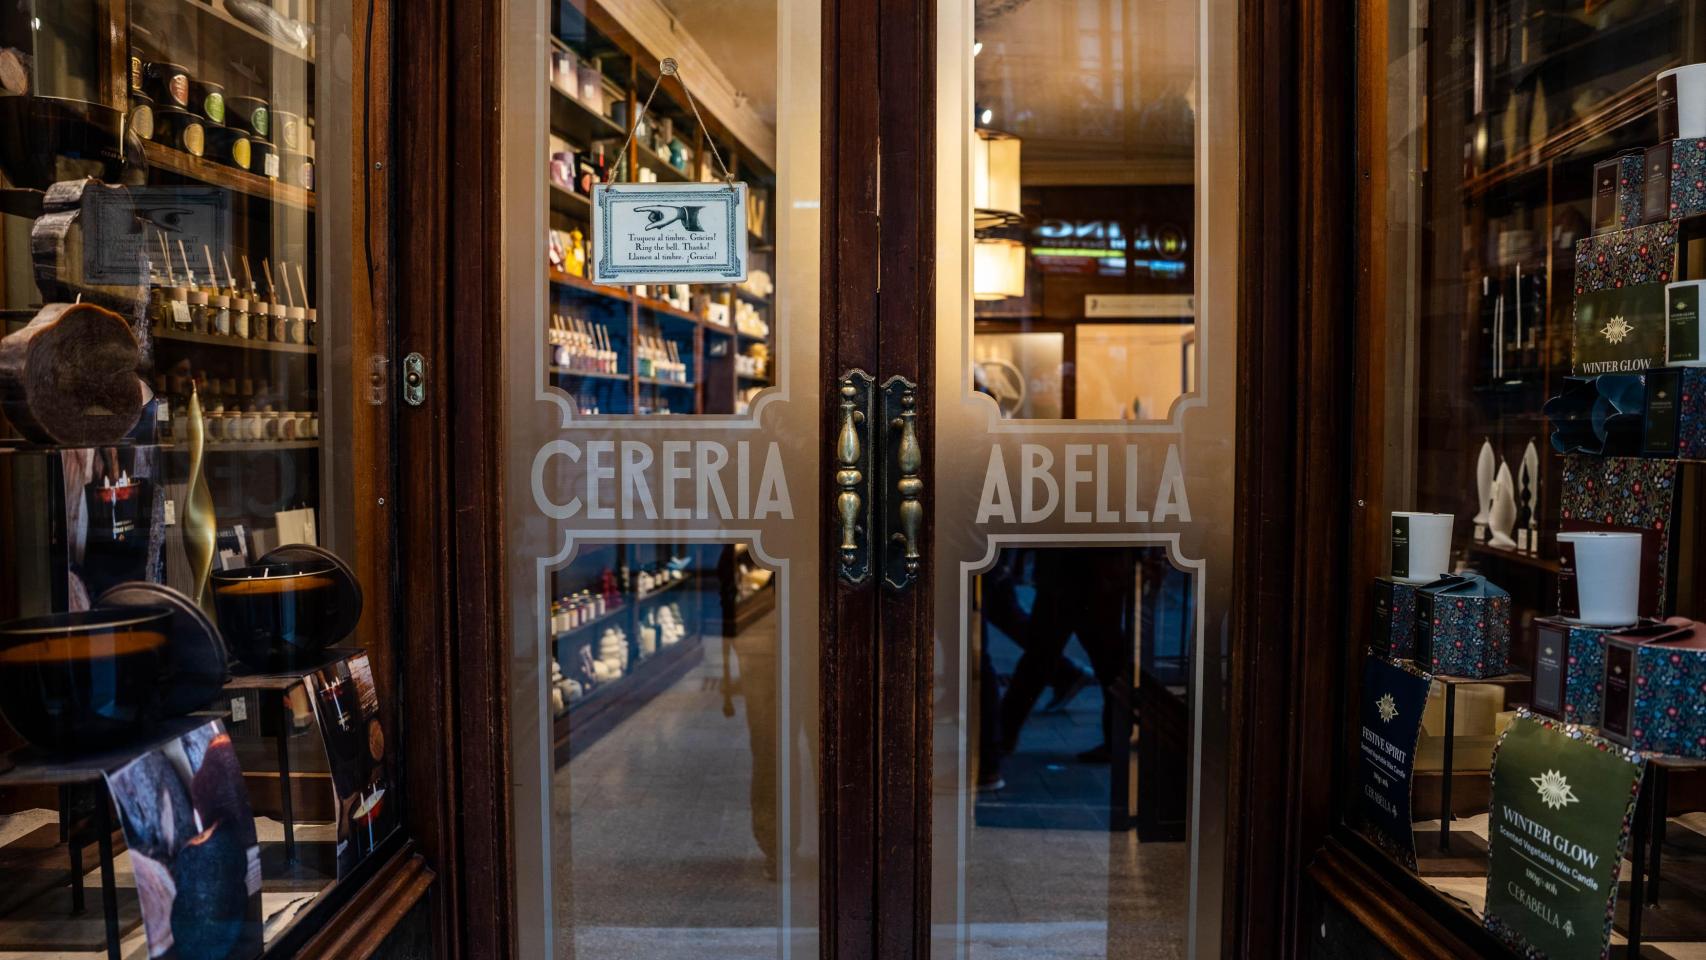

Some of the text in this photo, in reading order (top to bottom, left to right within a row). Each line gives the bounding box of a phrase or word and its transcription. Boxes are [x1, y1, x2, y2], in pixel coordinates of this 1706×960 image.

[628, 233, 656, 243] Truqueu
[658, 233, 664, 241] al
[665, 233, 687, 241] timbre.
[635, 242, 710, 253] Ring the bell. Thanks!
[654, 252, 660, 260] al
[662, 252, 685, 260] timbre.
[687, 251, 717, 264] ¡Gracias!
[1583, 358, 1652, 374] WINTER GLOW
[531, 440, 1192, 524] CERERIA ABELLA
[1362, 726, 1407, 764] FESTIVE SPIRIT
[1503, 805, 1600, 870] WINTER GLOW
[1499, 825, 1599, 891] Scented Vegetable Wax Candle
[1507, 880, 1560, 929] CERABELLA
